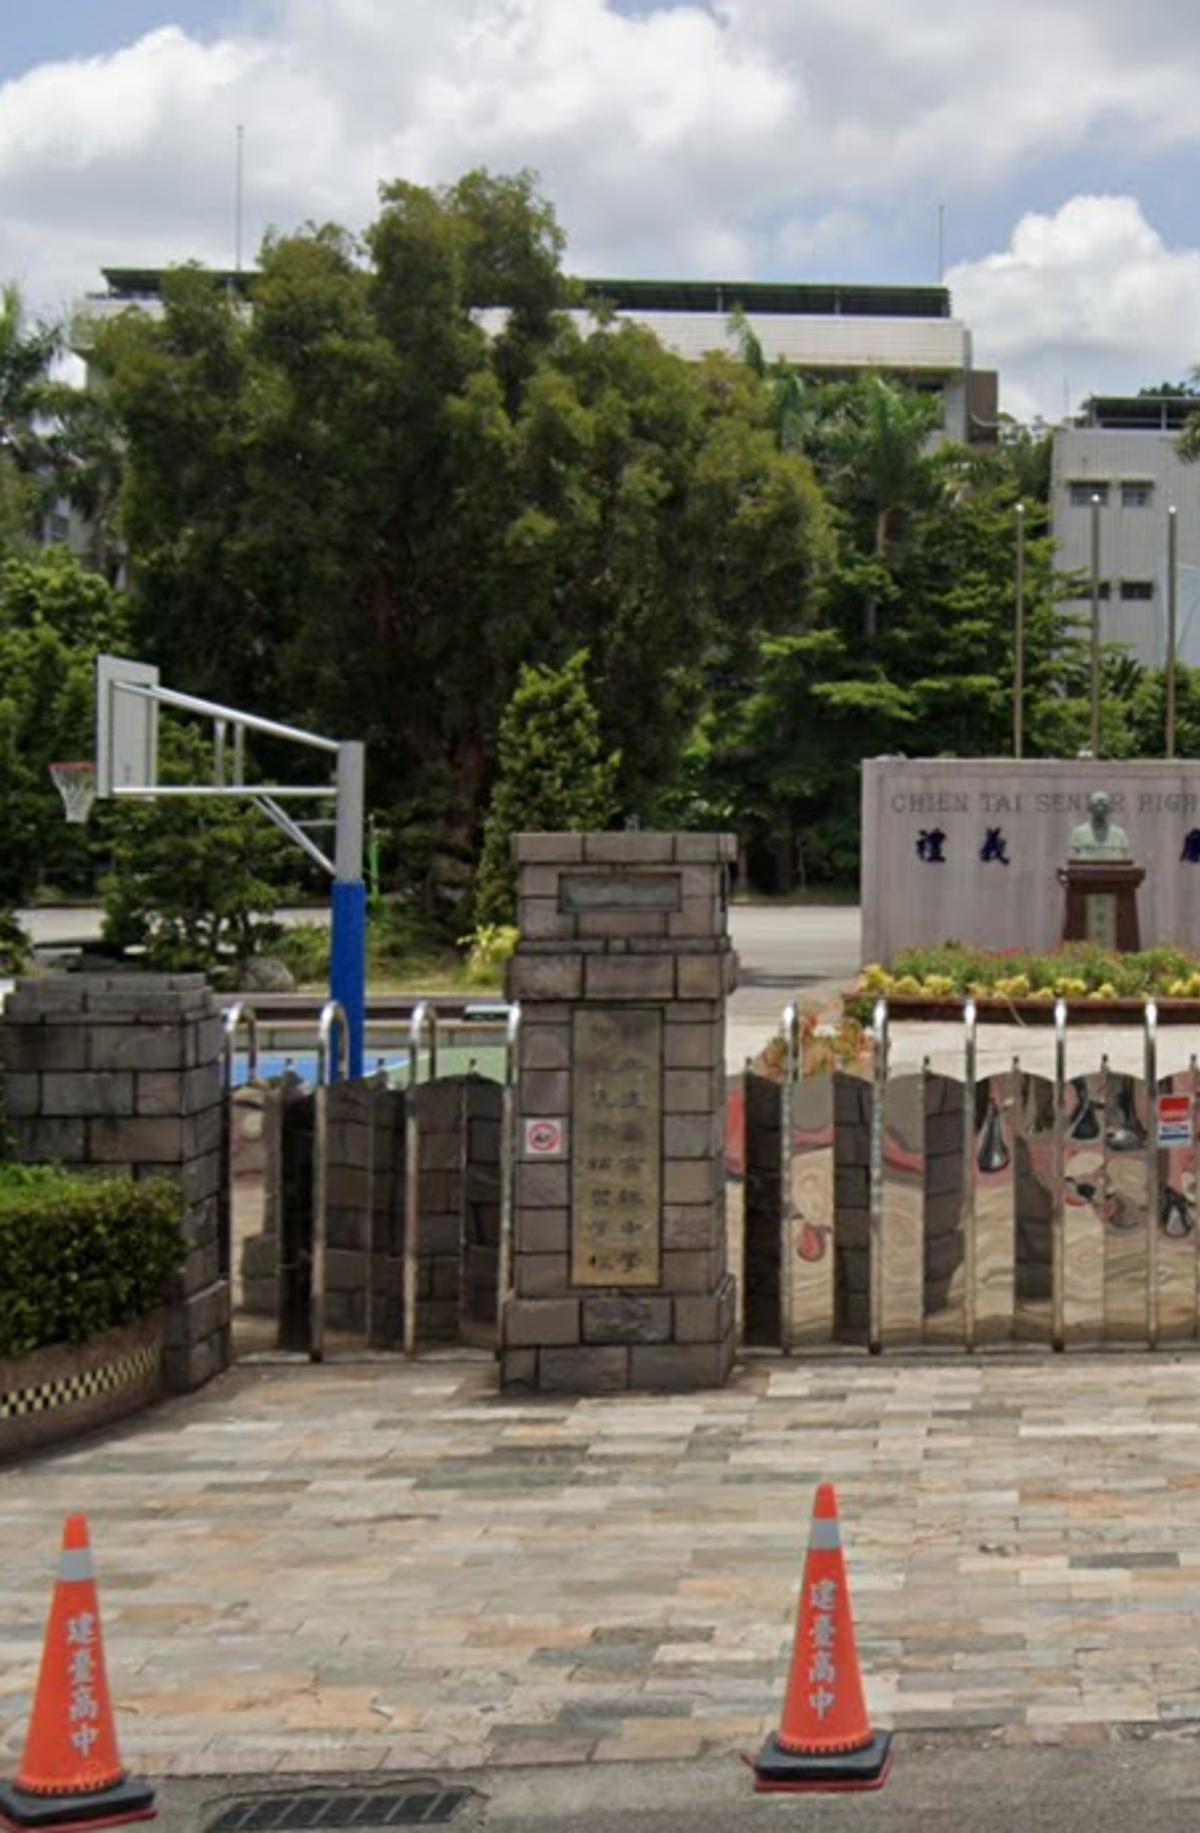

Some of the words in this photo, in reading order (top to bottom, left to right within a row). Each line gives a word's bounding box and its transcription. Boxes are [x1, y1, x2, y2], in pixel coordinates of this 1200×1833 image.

[890, 793, 968, 813] CHIEN
[979, 793, 1022, 813] TAI
[1036, 793, 1126, 813] SENIR
[1137, 793, 1198, 813] HIGH
